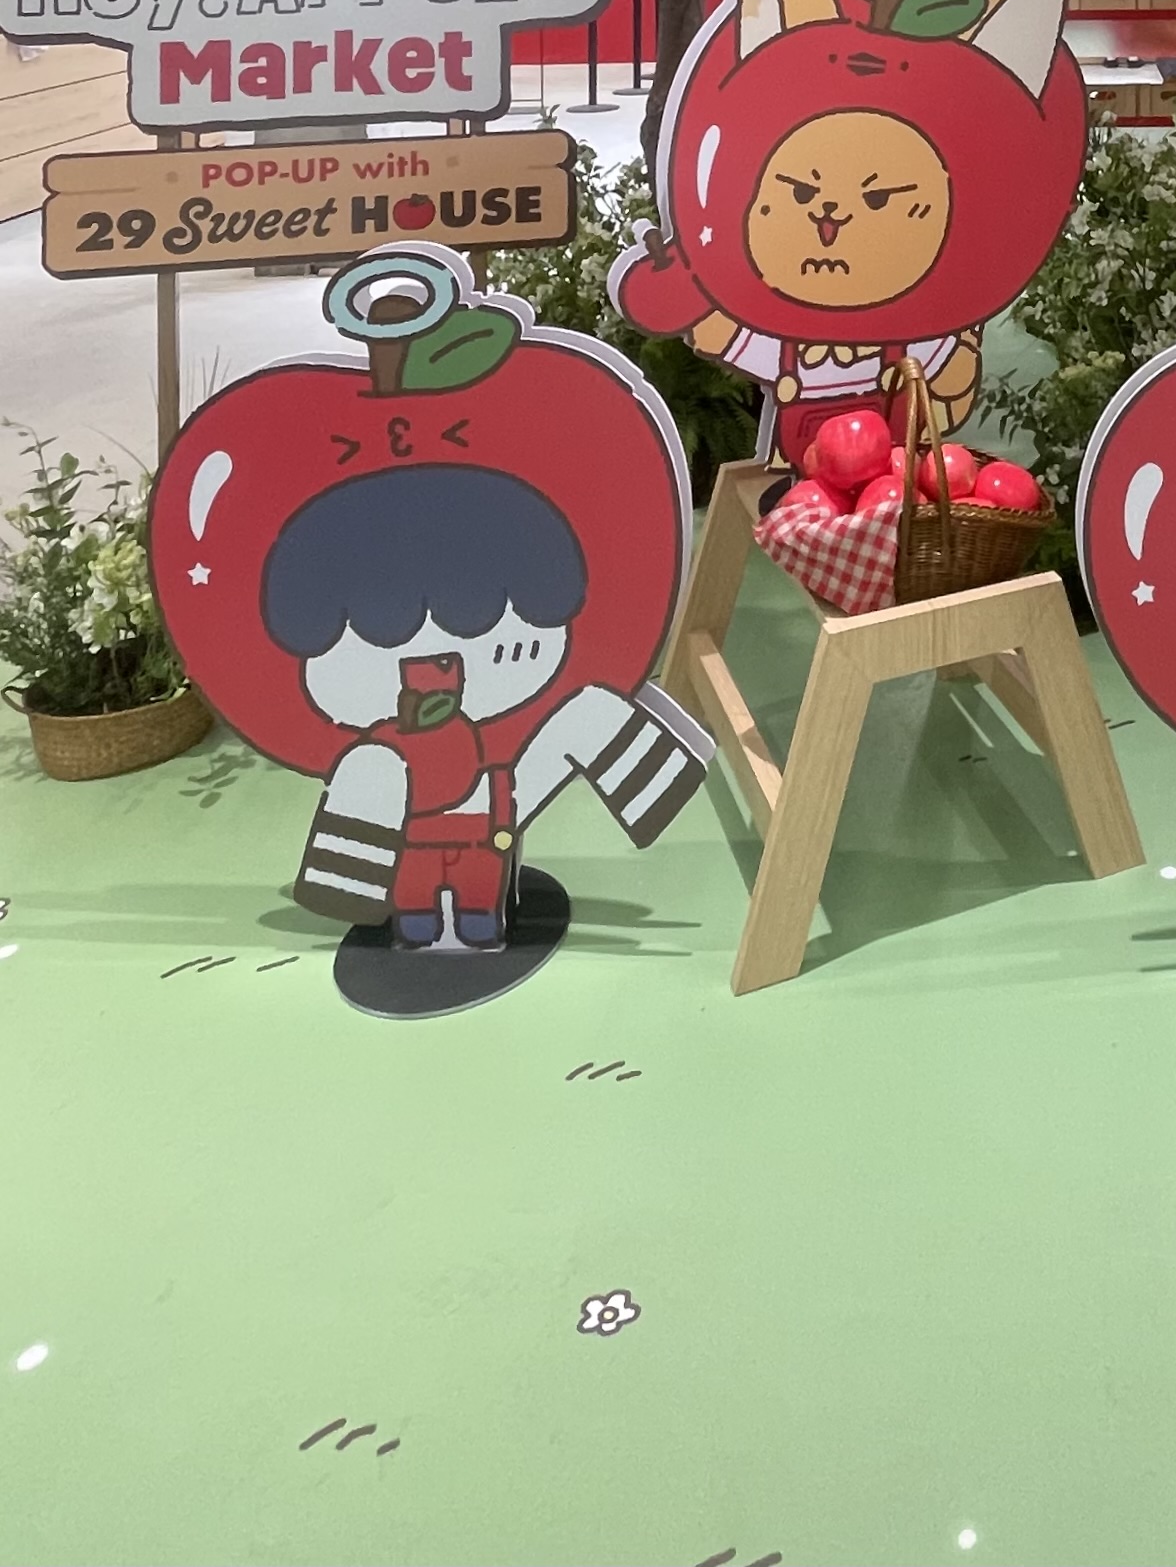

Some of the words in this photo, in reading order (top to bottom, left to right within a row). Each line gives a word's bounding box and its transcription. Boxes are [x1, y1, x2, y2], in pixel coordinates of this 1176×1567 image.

[159, 29, 473, 105] Market
[202, 156, 339, 189] POP-UP
[353, 151, 430, 180] with
[75, 208, 156, 252] 29
[162, 196, 338, 255] Sweet
